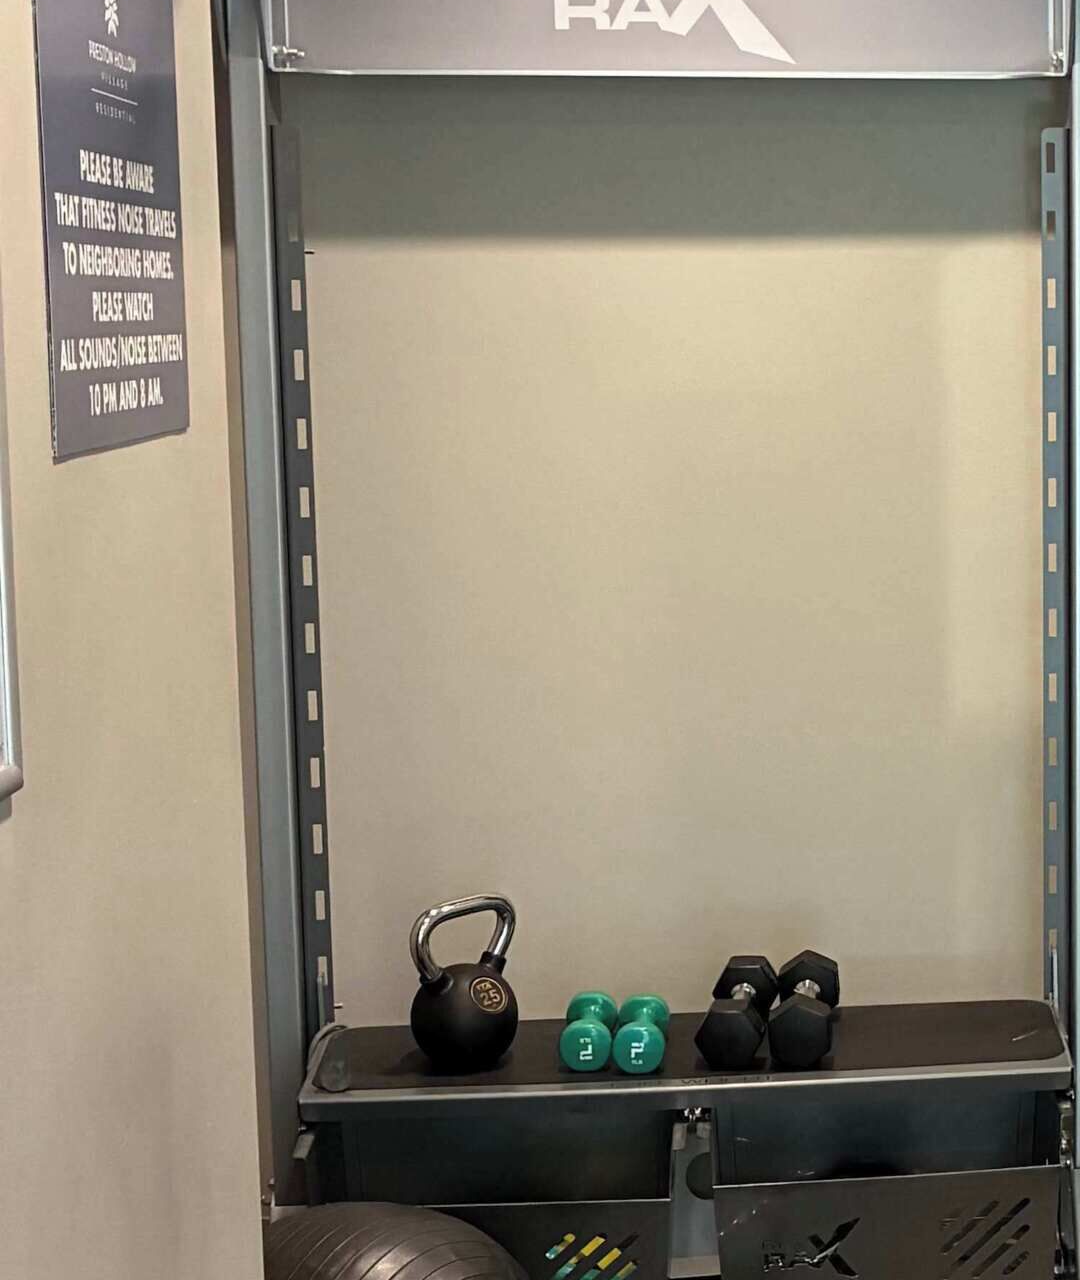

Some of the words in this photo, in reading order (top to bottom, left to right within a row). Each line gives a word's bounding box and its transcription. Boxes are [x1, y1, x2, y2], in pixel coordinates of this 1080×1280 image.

[88, 40, 113, 64] PRESTON
[80, 149, 111, 186] PLEASE
[113, 157, 123, 188] BE
[125, 160, 154, 194] AWARE
[54, 192, 79, 227] THAT
[81, 196, 116, 232] FITNESS
[117, 202, 144, 235] NOISE
[144, 207, 176, 239] TRAVELS
[63, 241, 77, 275] TO
[79, 243, 141, 278] NEIGHBORING
[143, 249, 174, 279] HOMES.
[92, 291, 123, 322] PLEASE
[124, 292, 153, 321] WATCH
[60, 339, 77, 371] ALL
[79, 333, 146, 370] SOUNDS/NOISE
[147, 334, 183, 363] BETWEEN
[89, 383, 101, 416] 10
[103, 382, 117, 414] PM
[119, 380, 138, 411] AND
[140, 378, 146, 408] 8
[147, 377, 164, 406] AM.
[480, 989, 500, 1006] 25
